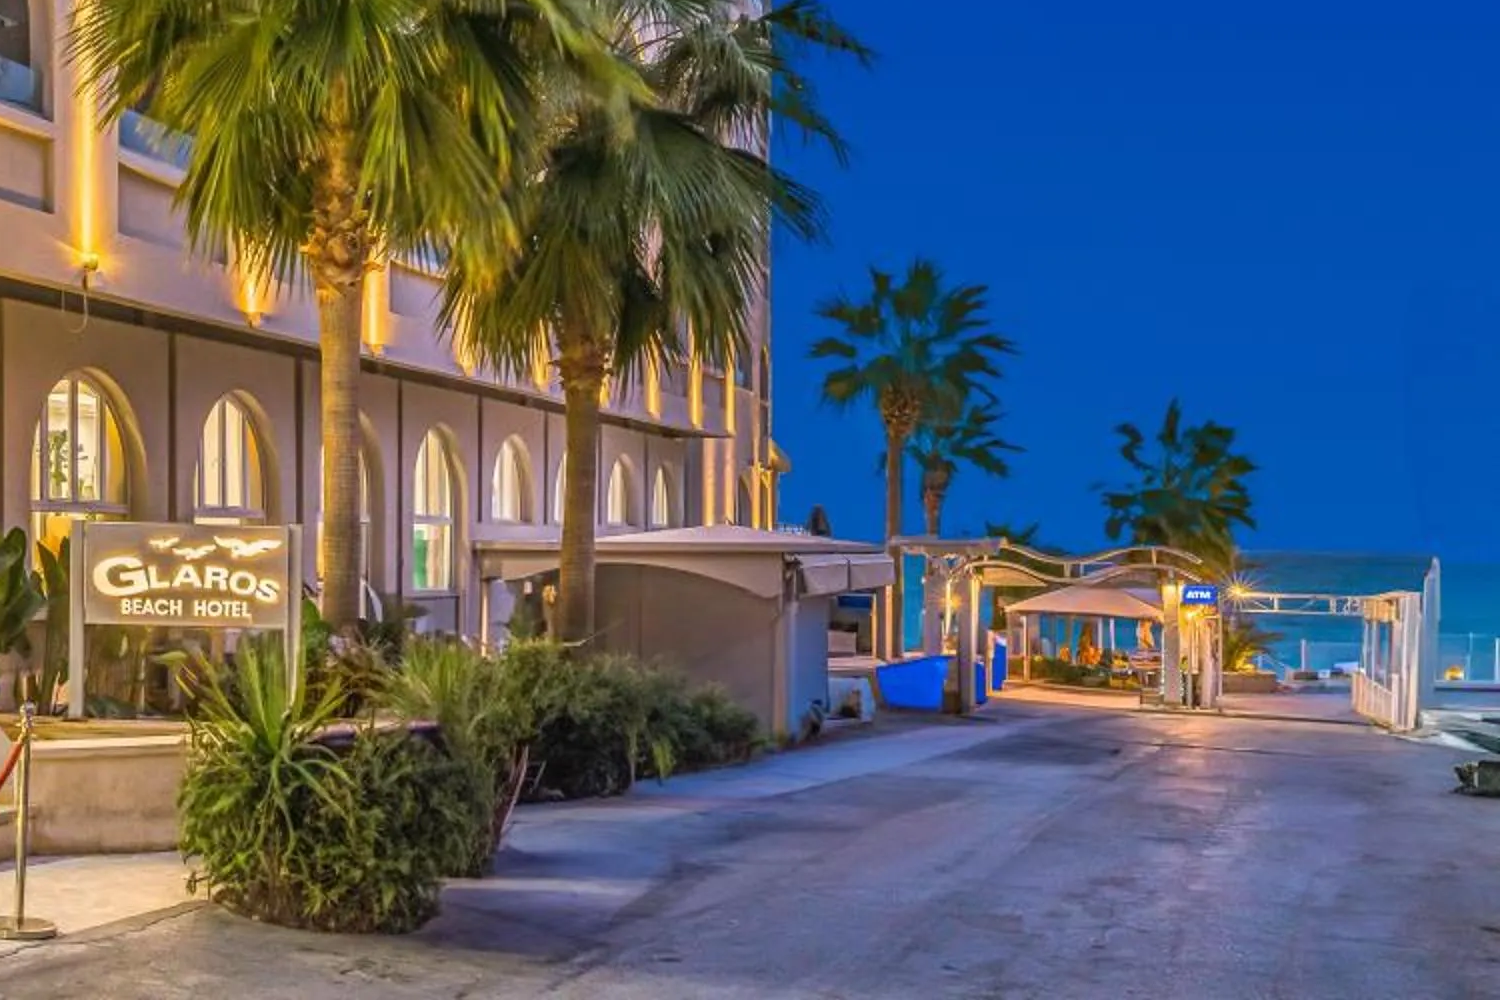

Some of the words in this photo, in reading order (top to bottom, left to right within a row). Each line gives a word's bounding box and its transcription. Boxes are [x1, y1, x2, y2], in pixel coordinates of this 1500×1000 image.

[93, 556, 280, 603] GLAROS
[1186, 590, 1211, 600] ATM
[120, 598, 183, 617] BEACH
[193, 599, 251, 617] HOTEL
